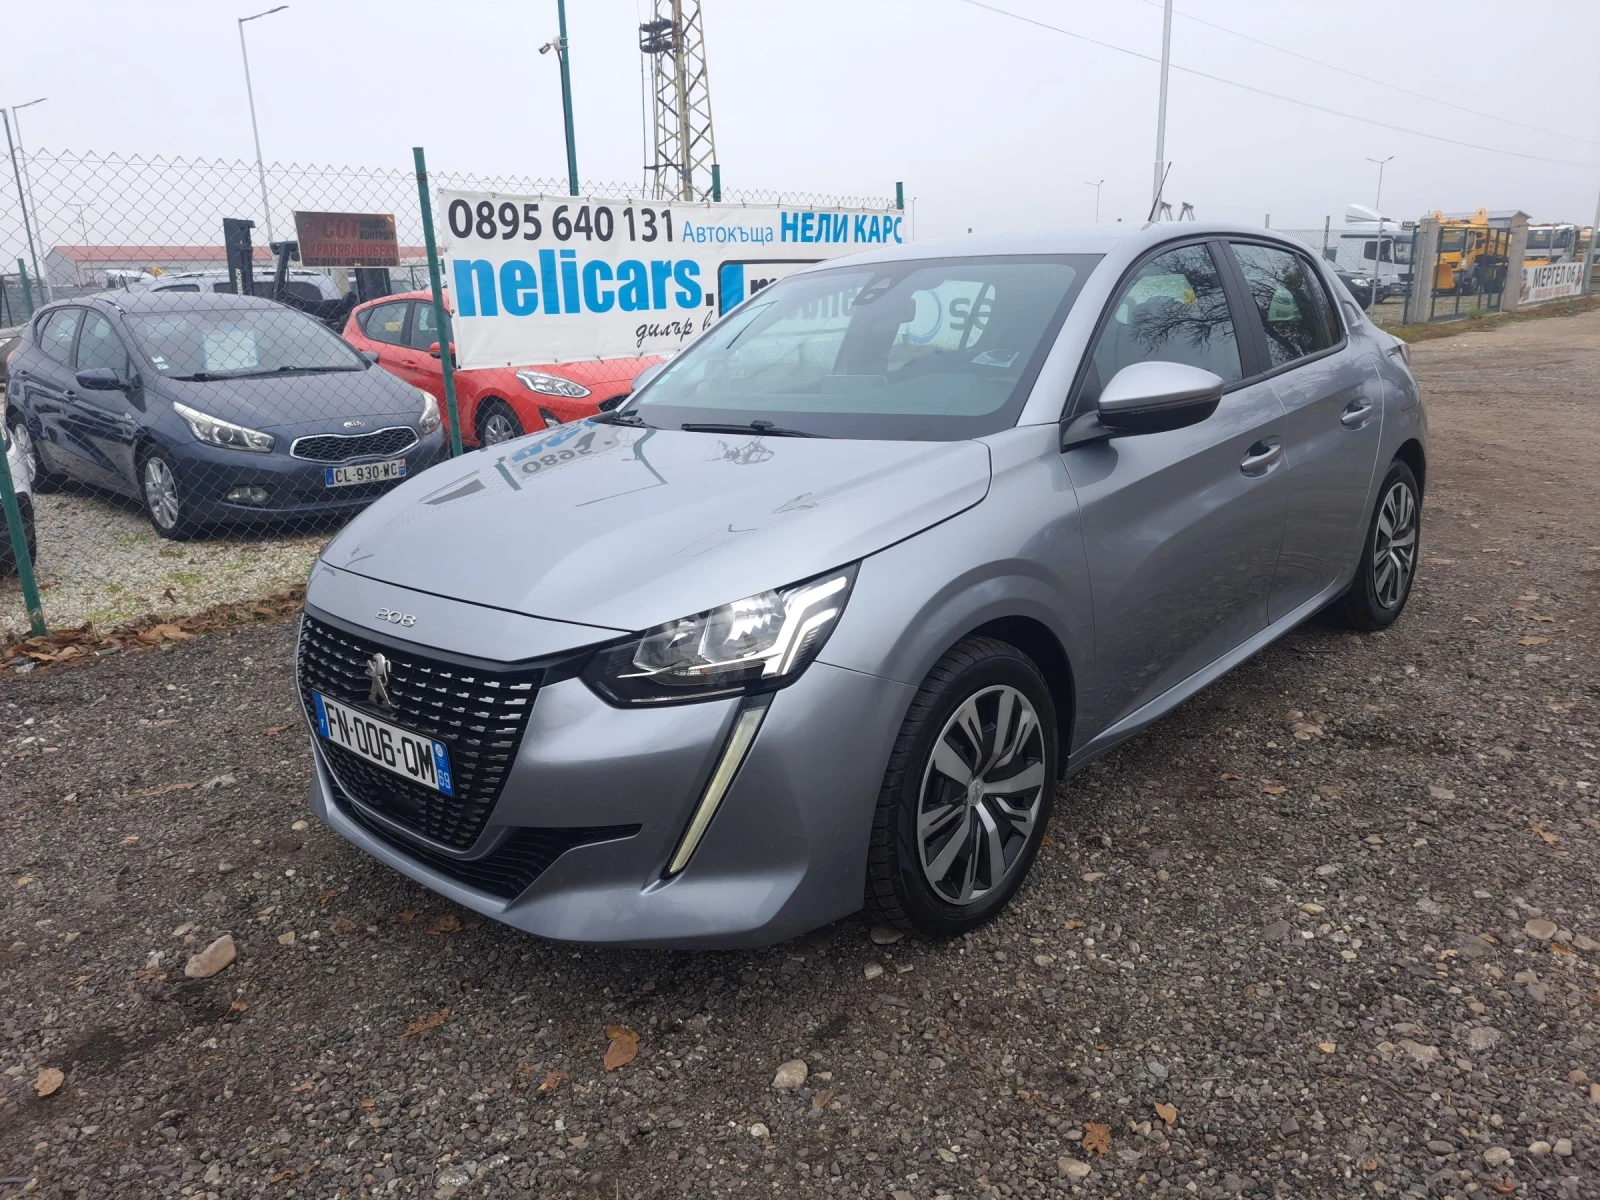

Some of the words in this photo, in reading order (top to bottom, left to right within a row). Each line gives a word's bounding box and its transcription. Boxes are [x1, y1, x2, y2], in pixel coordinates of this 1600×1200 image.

[448, 199, 542, 240] 0895
[552, 205, 614, 242] 640
[623, 207, 673, 242] 131
[682, 221, 773, 246] Автокъща
[781, 212, 848, 243] НЕЛИ
[854, 215, 903, 244] КАРС
[303, 243, 365, 258] ОХРАНЯВАН
[1533, 266, 1566, 288] МЕРГЕЛ
[636, 318, 693, 348] дилър
[335, 463, 397, 483] CL-930-WC
[375, 607, 417, 628] 208
[324, 701, 436, 784] FN-006-QM
[437, 769, 451, 789] 69
